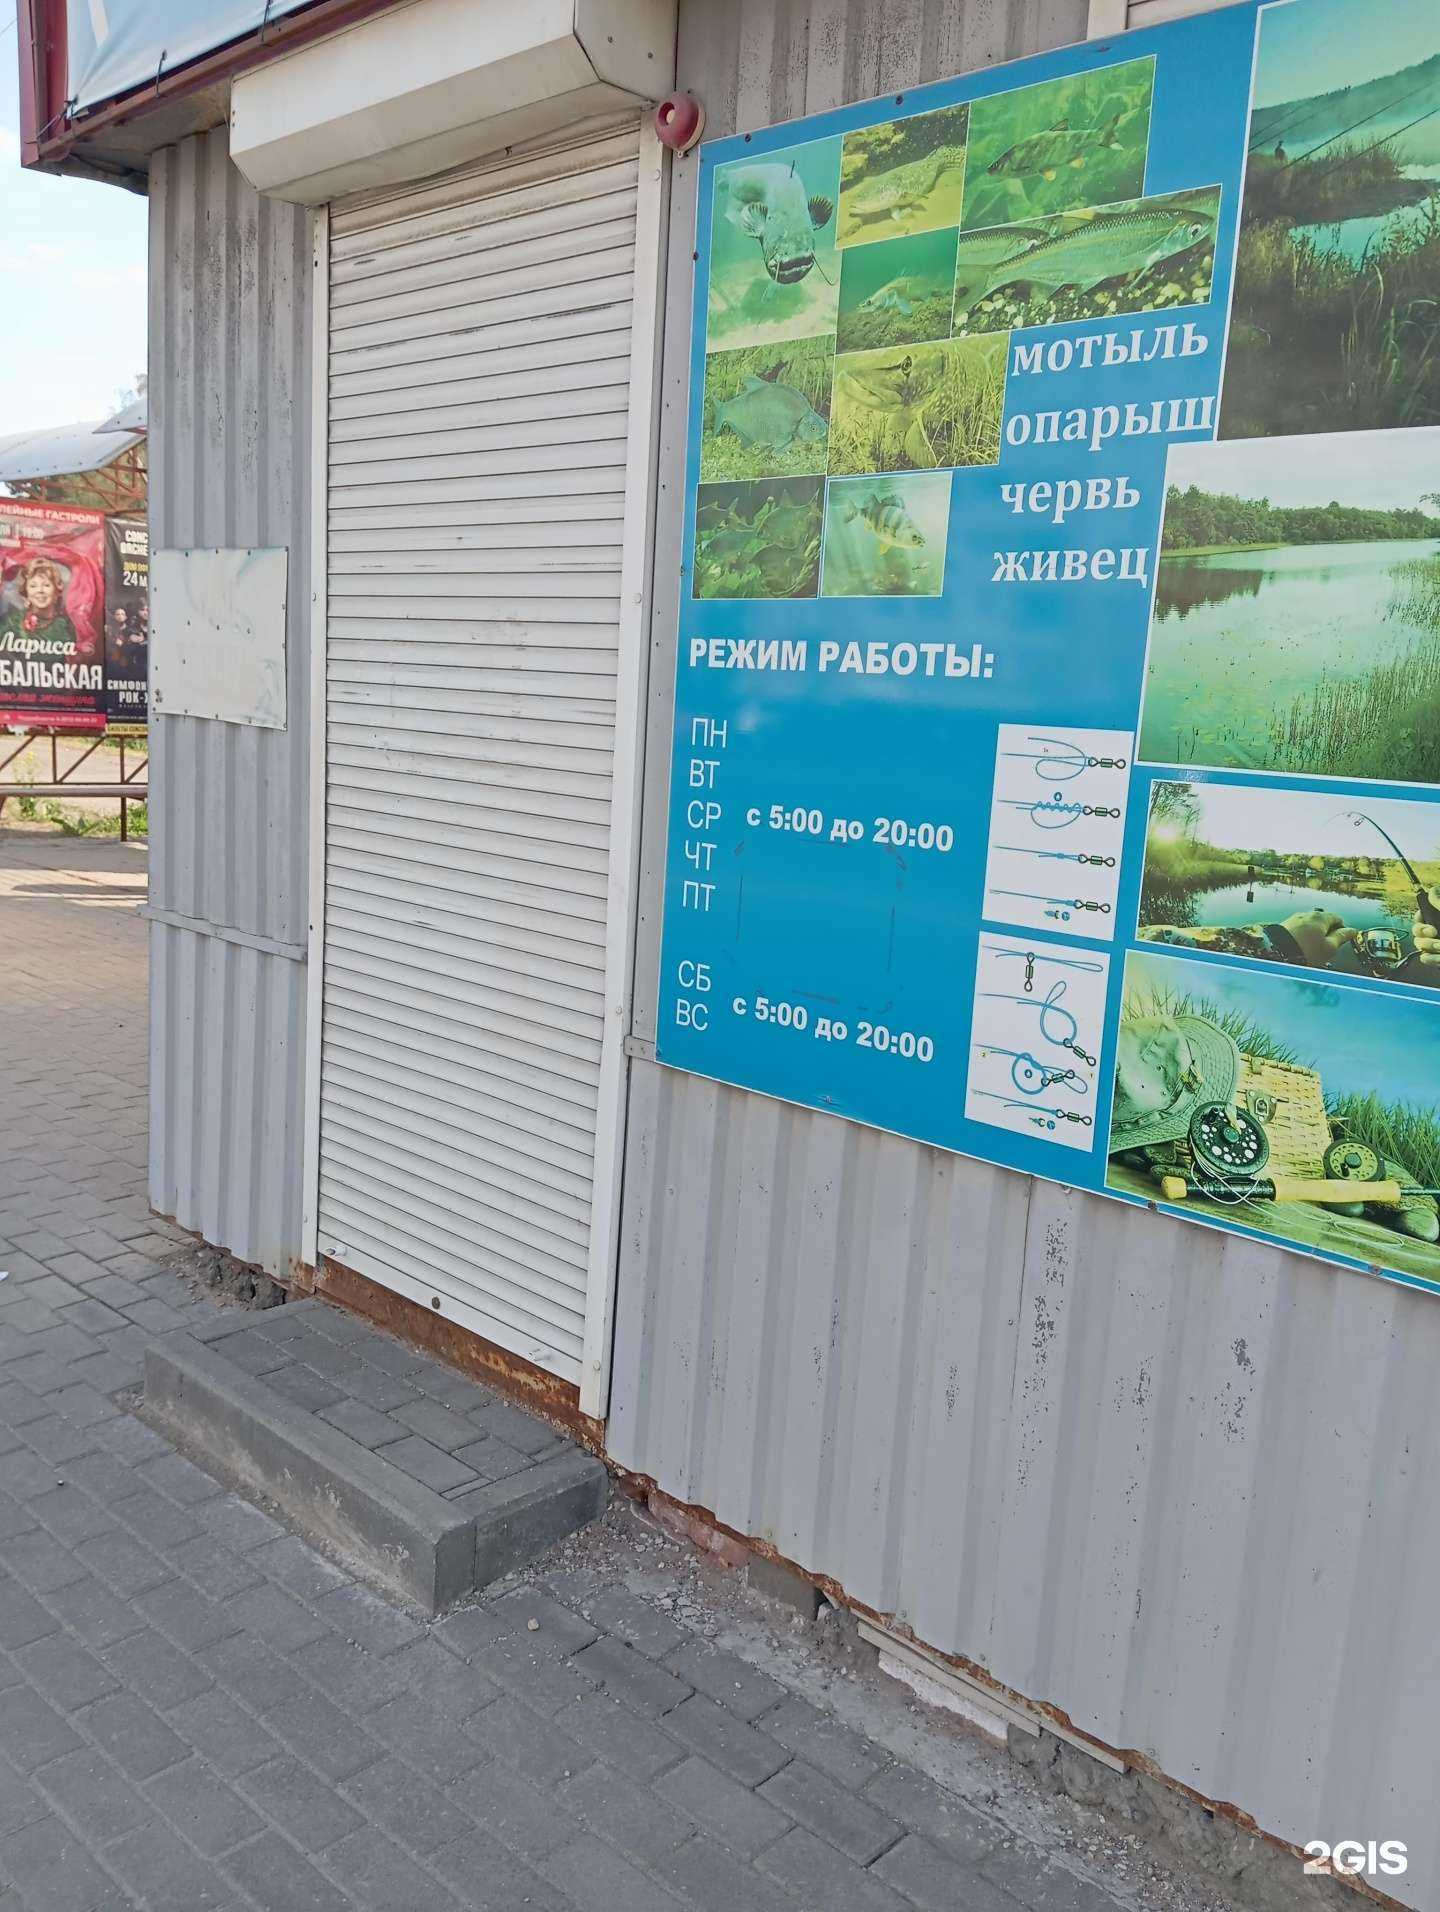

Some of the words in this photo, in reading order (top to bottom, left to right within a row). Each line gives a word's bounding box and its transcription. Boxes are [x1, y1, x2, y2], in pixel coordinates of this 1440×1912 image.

[1011, 323, 1208, 376] мотыль
[1006, 396, 1215, 451] опарыш
[1000, 476, 1140, 523] червь
[45, 509, 100, 524] ГАСТРОЛИ
[123, 571, 138, 586] 24
[991, 547, 1149, 588] живец
[0, 631, 77, 659] Лариса
[689, 638, 807, 671] РЕЖИМ
[818, 641, 995, 678] РАБОТЫ:
[0, 659, 103, 690] БАЛЬСКАЯ
[691, 717, 728, 748] ПН
[689, 758, 721, 789] ВТ
[687, 800, 722, 830] СР
[746, 808, 761, 826] с
[768, 804, 824, 834] 5:00
[830, 818, 864, 843] до
[872, 817, 954, 852] 20:00
[684, 840, 718, 871] ЧТ
[682, 880, 716, 912] ПТ
[677, 960, 711, 992] СБ
[675, 998, 709, 1031] ВС
[732, 997, 747, 1015] с
[754, 996, 808, 1030] 5:00
[814, 1017, 848, 1041] до
[855, 1021, 934, 1063] 20:00
